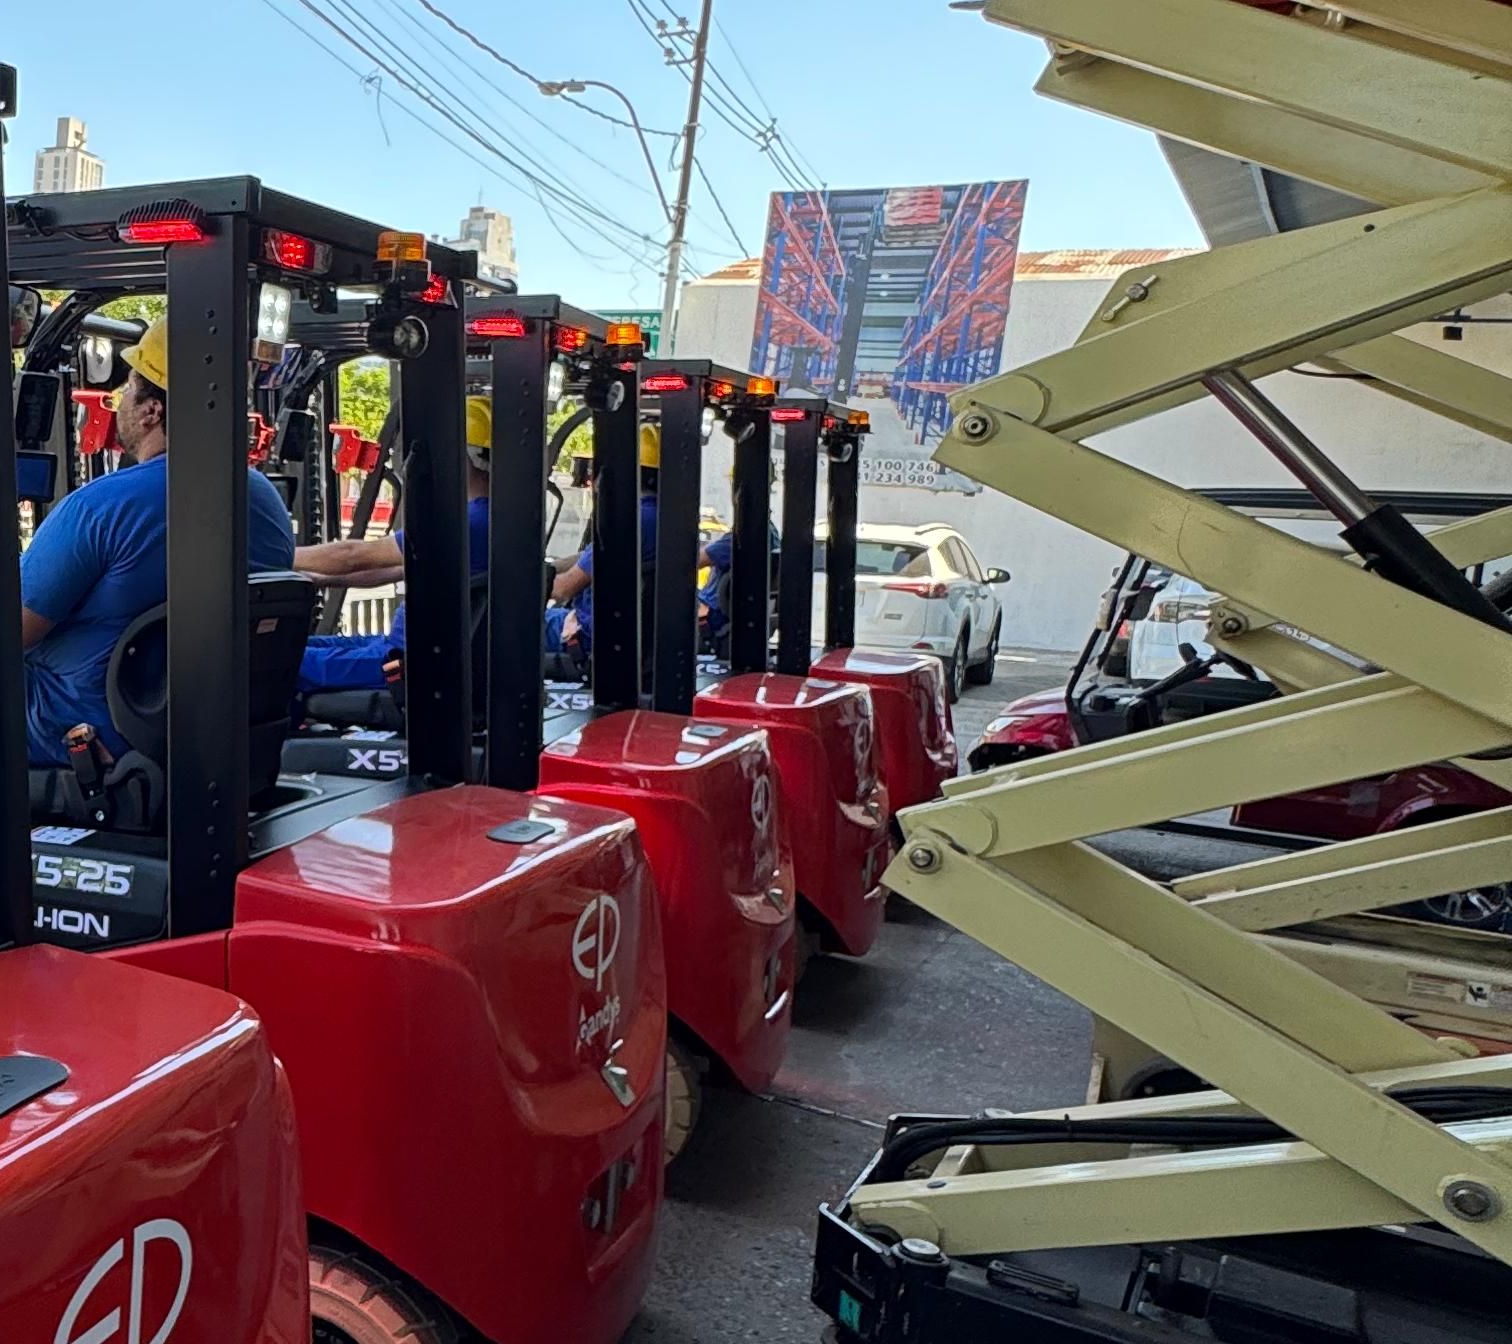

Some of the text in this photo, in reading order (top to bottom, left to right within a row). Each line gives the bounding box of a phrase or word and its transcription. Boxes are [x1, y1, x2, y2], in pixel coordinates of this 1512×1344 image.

[876, 460, 902, 472] 100
[907, 461, 934, 473] 746
[876, 473, 902, 484] 234
[907, 474, 935, 485] 989
[31, 854, 131, 896] 5-25
[572, 895, 621, 993] EP
